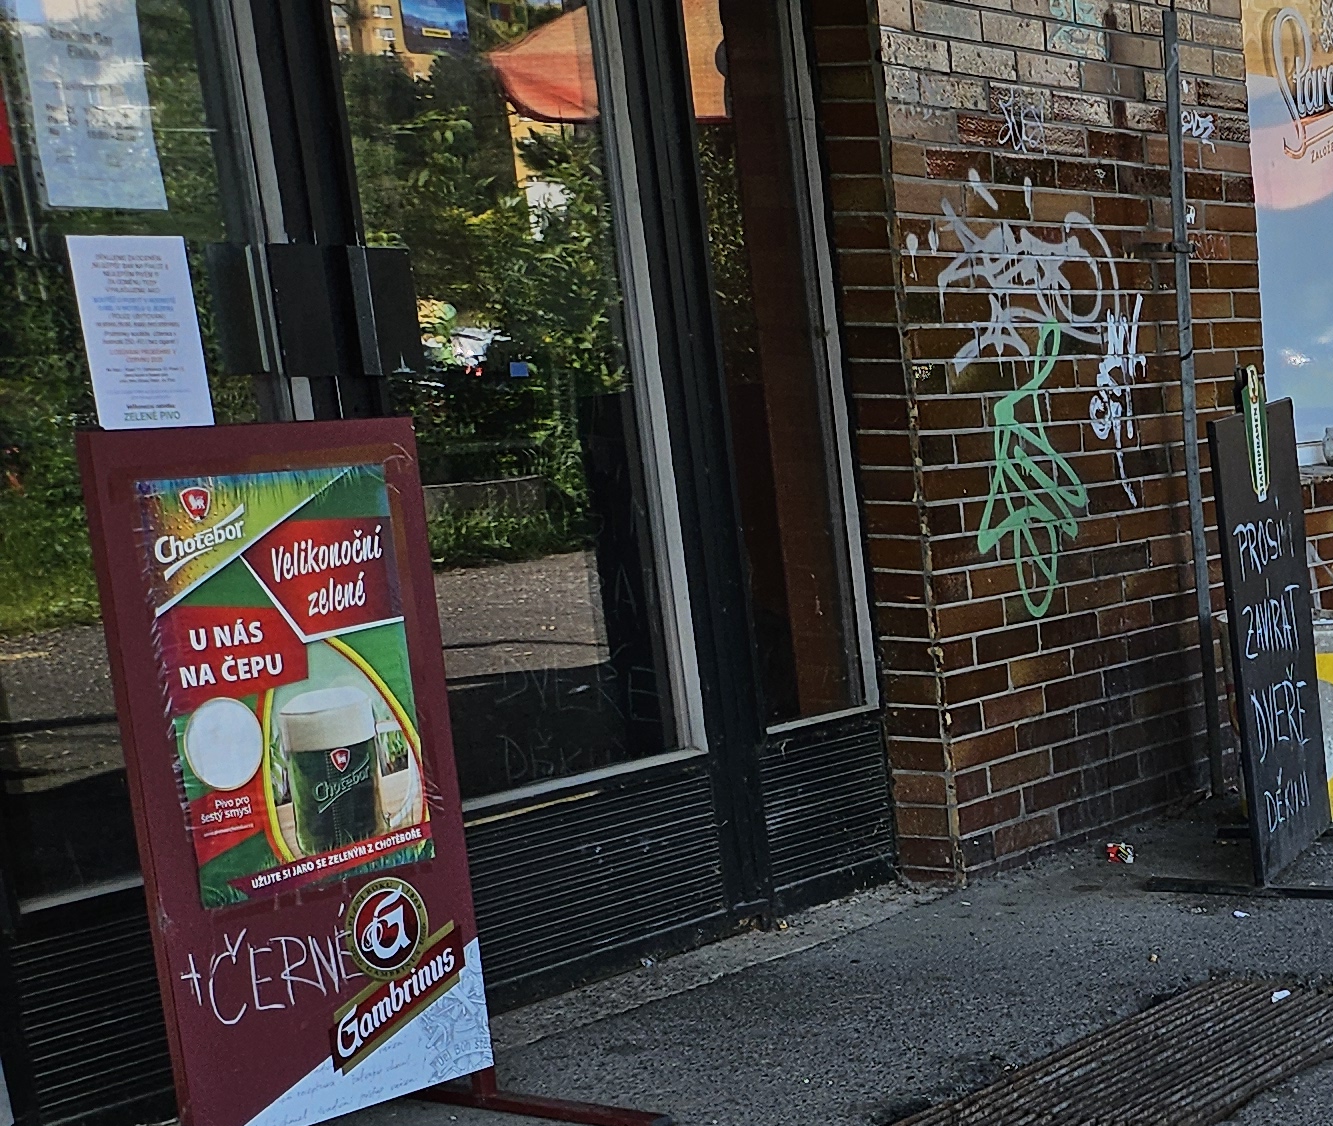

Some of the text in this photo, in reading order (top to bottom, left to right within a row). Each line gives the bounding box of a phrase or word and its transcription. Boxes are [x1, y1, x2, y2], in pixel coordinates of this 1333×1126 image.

[160, 411, 180, 420] PIVO
[1252, 406, 1267, 498] STAROPRAMEN
[271, 525, 383, 583] Velikonoční
[308, 571, 367, 617] zelené
[189, 618, 265, 651] U NÁS
[1241, 578, 1300, 660] ZAVÍRAT
[179, 653, 283, 689] NA ČEPU
[235, 795, 250, 808] pro
[292, 861, 315, 877] JARO
[316, 857, 328, 870] SE
[328, 844, 367, 866] ZELENÝM
[367, 844, 375, 854] Z
[336, 946, 456, 1059] Gambrinus
